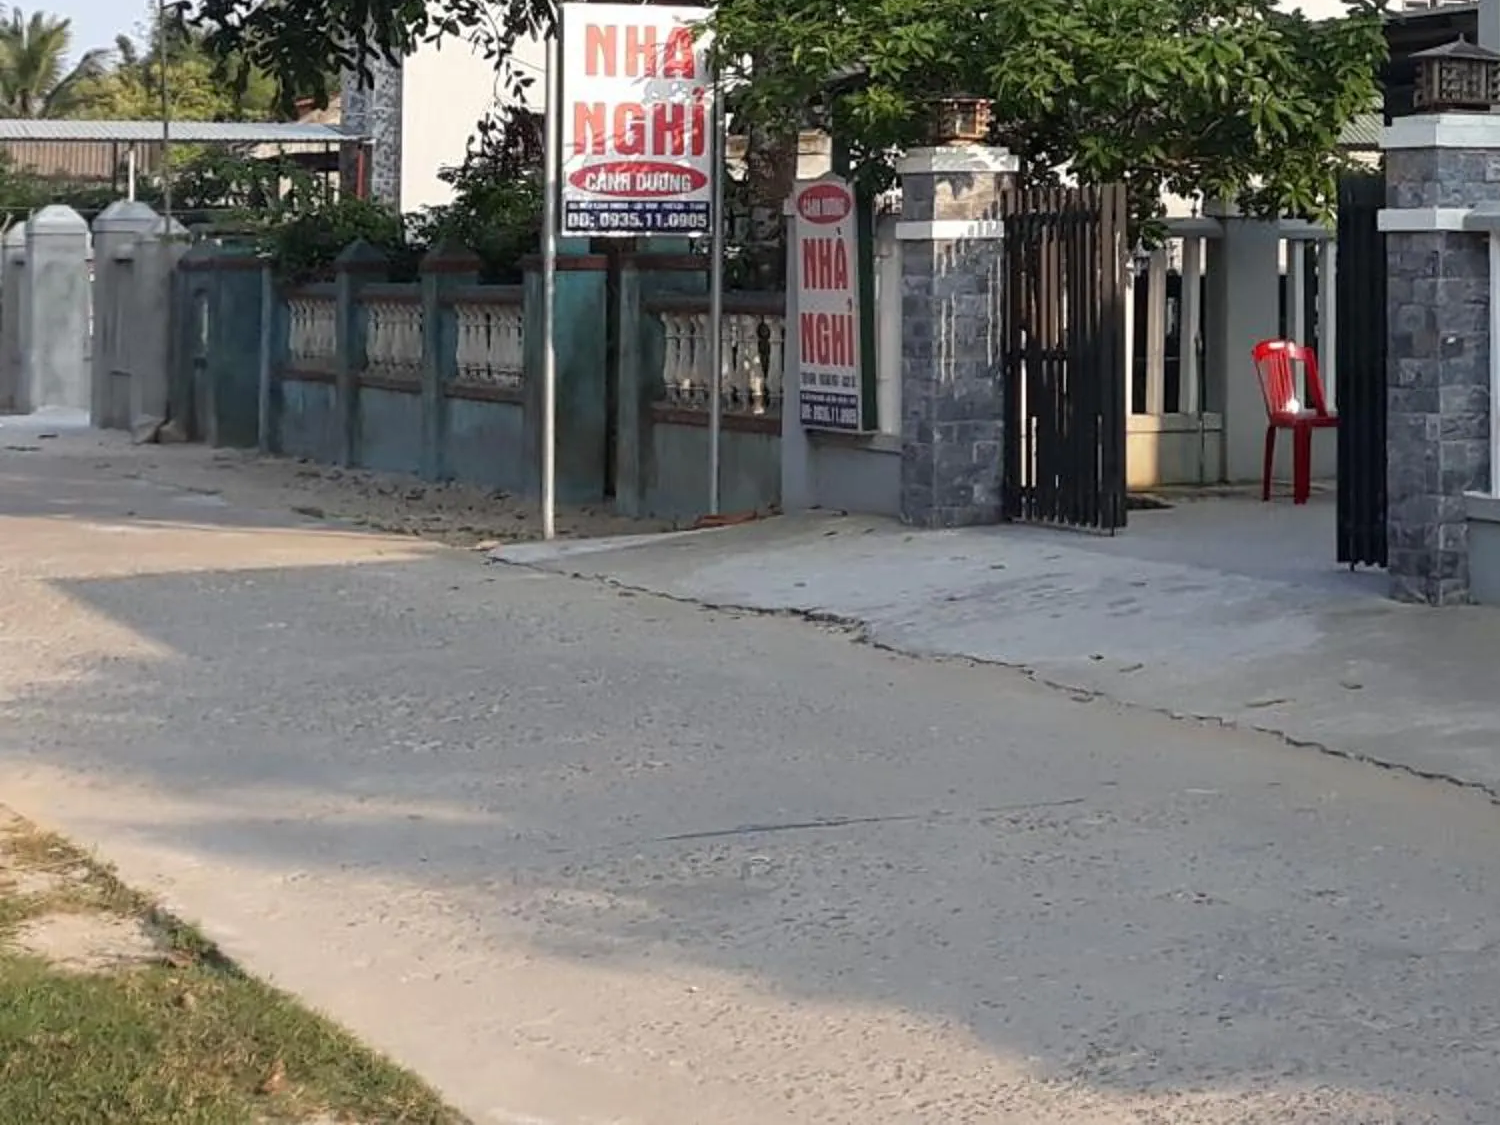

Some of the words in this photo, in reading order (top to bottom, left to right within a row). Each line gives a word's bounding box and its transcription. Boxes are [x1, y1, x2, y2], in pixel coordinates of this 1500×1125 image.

[573, 87, 706, 156] NGHỈ
[803, 226, 849, 290] NHÀ
[801, 298, 854, 367] NGHỈ
